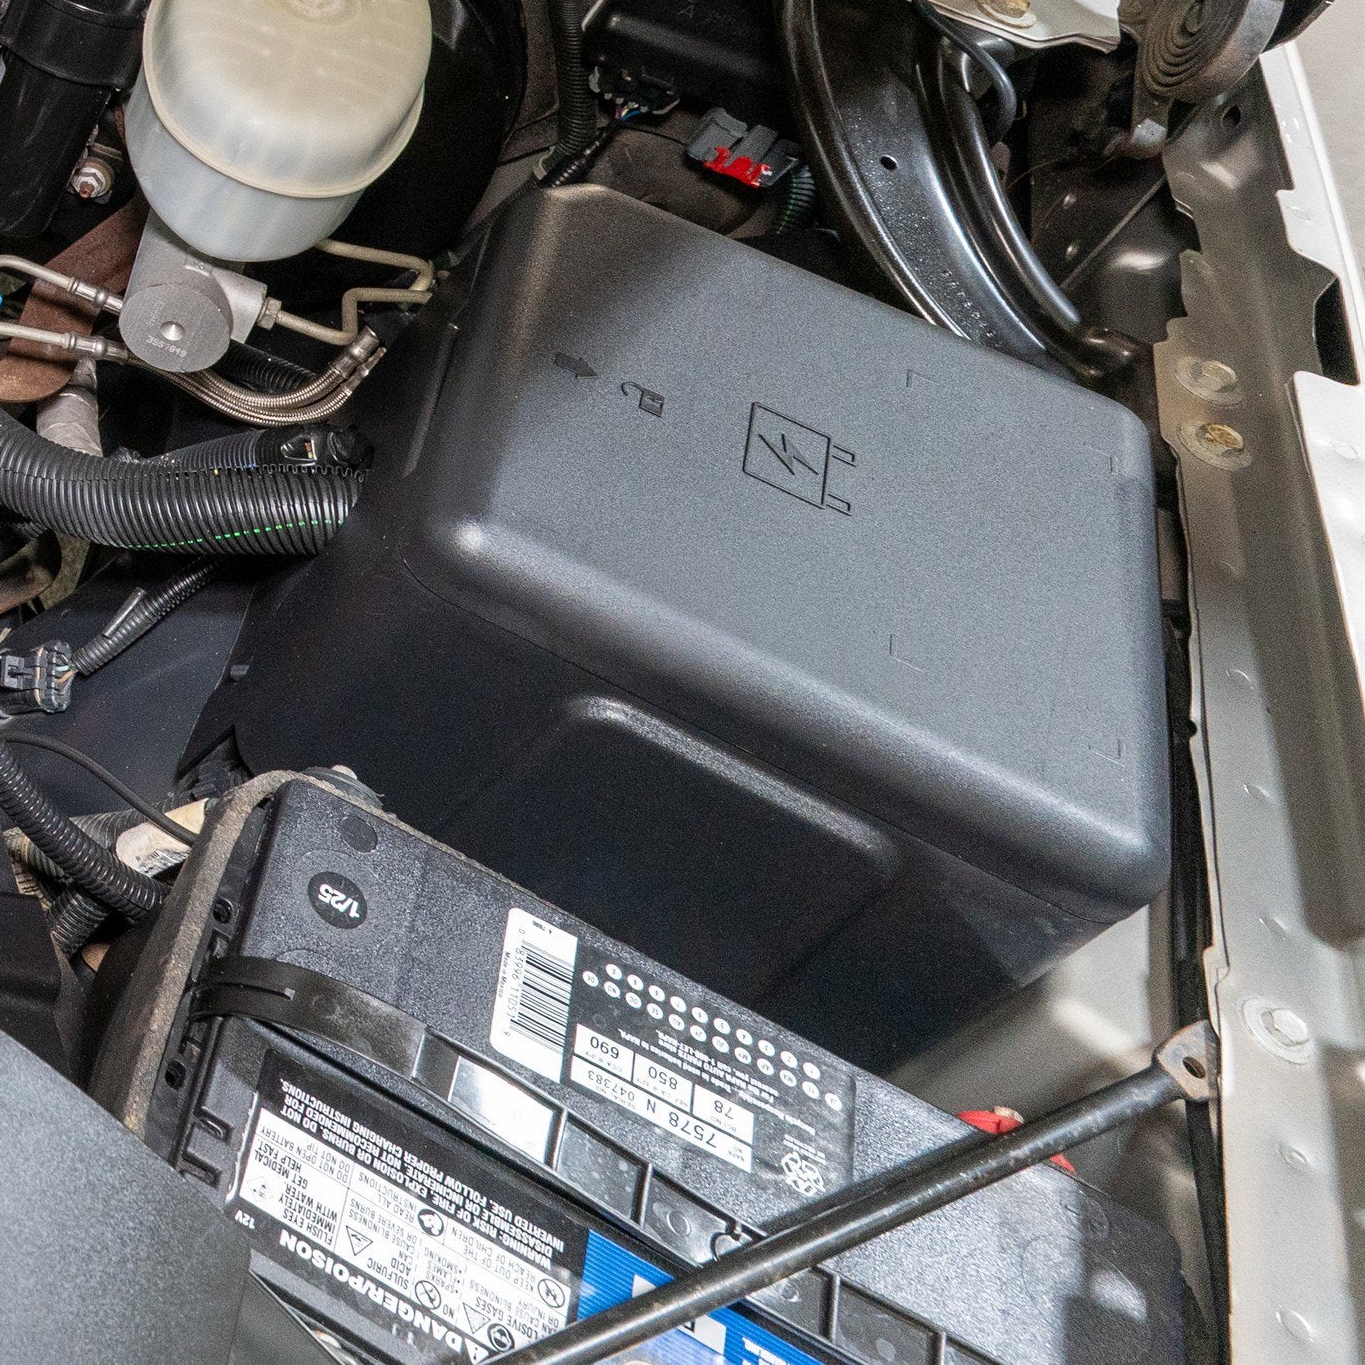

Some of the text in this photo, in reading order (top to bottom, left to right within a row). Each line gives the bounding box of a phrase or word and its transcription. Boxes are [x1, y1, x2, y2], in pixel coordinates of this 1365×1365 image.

[317, 883, 361, 919] 1/25
[510, 946, 525, 982] 83996
[505, 984, 519, 1020] 11051
[589, 1034, 619, 1060] 690
[677, 1048, 702, 1068] PARTS
[587, 1068, 635, 1102] 047383
[647, 1064, 677, 1090] 850
[702, 1061, 724, 1079] AUTO
[724, 1072, 746, 1090] NAPA
[645, 1097, 717, 1149] 7578 N
[712, 1098, 734, 1120] 78
[252, 1148, 308, 1190] GET MEDICAL
[254, 1137, 302, 1173] HELP FAST.
[278, 1075, 564, 1254] INVERTED USE. FOLLOW PROPER CHARGING INSTRUCTIONS.
[295, 1144, 317, 1165] OPEN
[317, 1158, 335, 1176] NOT
[320, 1148, 337, 1166] NOT
[337, 1158, 351, 1174] DO
[279, 1102, 551, 1272] WARNING: RISK OF FIRE, EXPLOSION OR BURNS. DO NOT
[282, 1092, 553, 1260] DISASSEMBLE OR INCINERATE. NOT RECOMMENDED FOR
[335, 1168, 348, 1184] DO
[357, 1170, 417, 1214] INSTRUCTIONS
[277, 1191, 336, 1234] IMMEDIATELY
[281, 1180, 338, 1223] WITH WATER.
[375, 1192, 415, 1223] READ ALL
[233, 1209, 257, 1231] 12V
[281, 1206, 333, 1246] FLUSH EYES
[347, 1207, 416, 1256] CAUSE BLINDNESS
[349, 1196, 418, 1245] OR SEVERE BURNS
[389, 1255, 411, 1277] ACID
[397, 1249, 413, 1266] CAN
[450, 1225, 536, 1284] REACH OF CHILDREN
[462, 1244, 534, 1294] KEEP OUT OF THE
[277, 1228, 465, 1348] DANGER/POISON
[365, 1256, 409, 1290] SULFURIC
[442, 1302, 455, 1319] NO
[468, 1278, 512, 1312] BLINDNESS
[517, 1296, 559, 1328] OR INJURY
[474, 1294, 545, 1347] LOSIVE GASES
[513, 1305, 540, 1329] CAUSE
